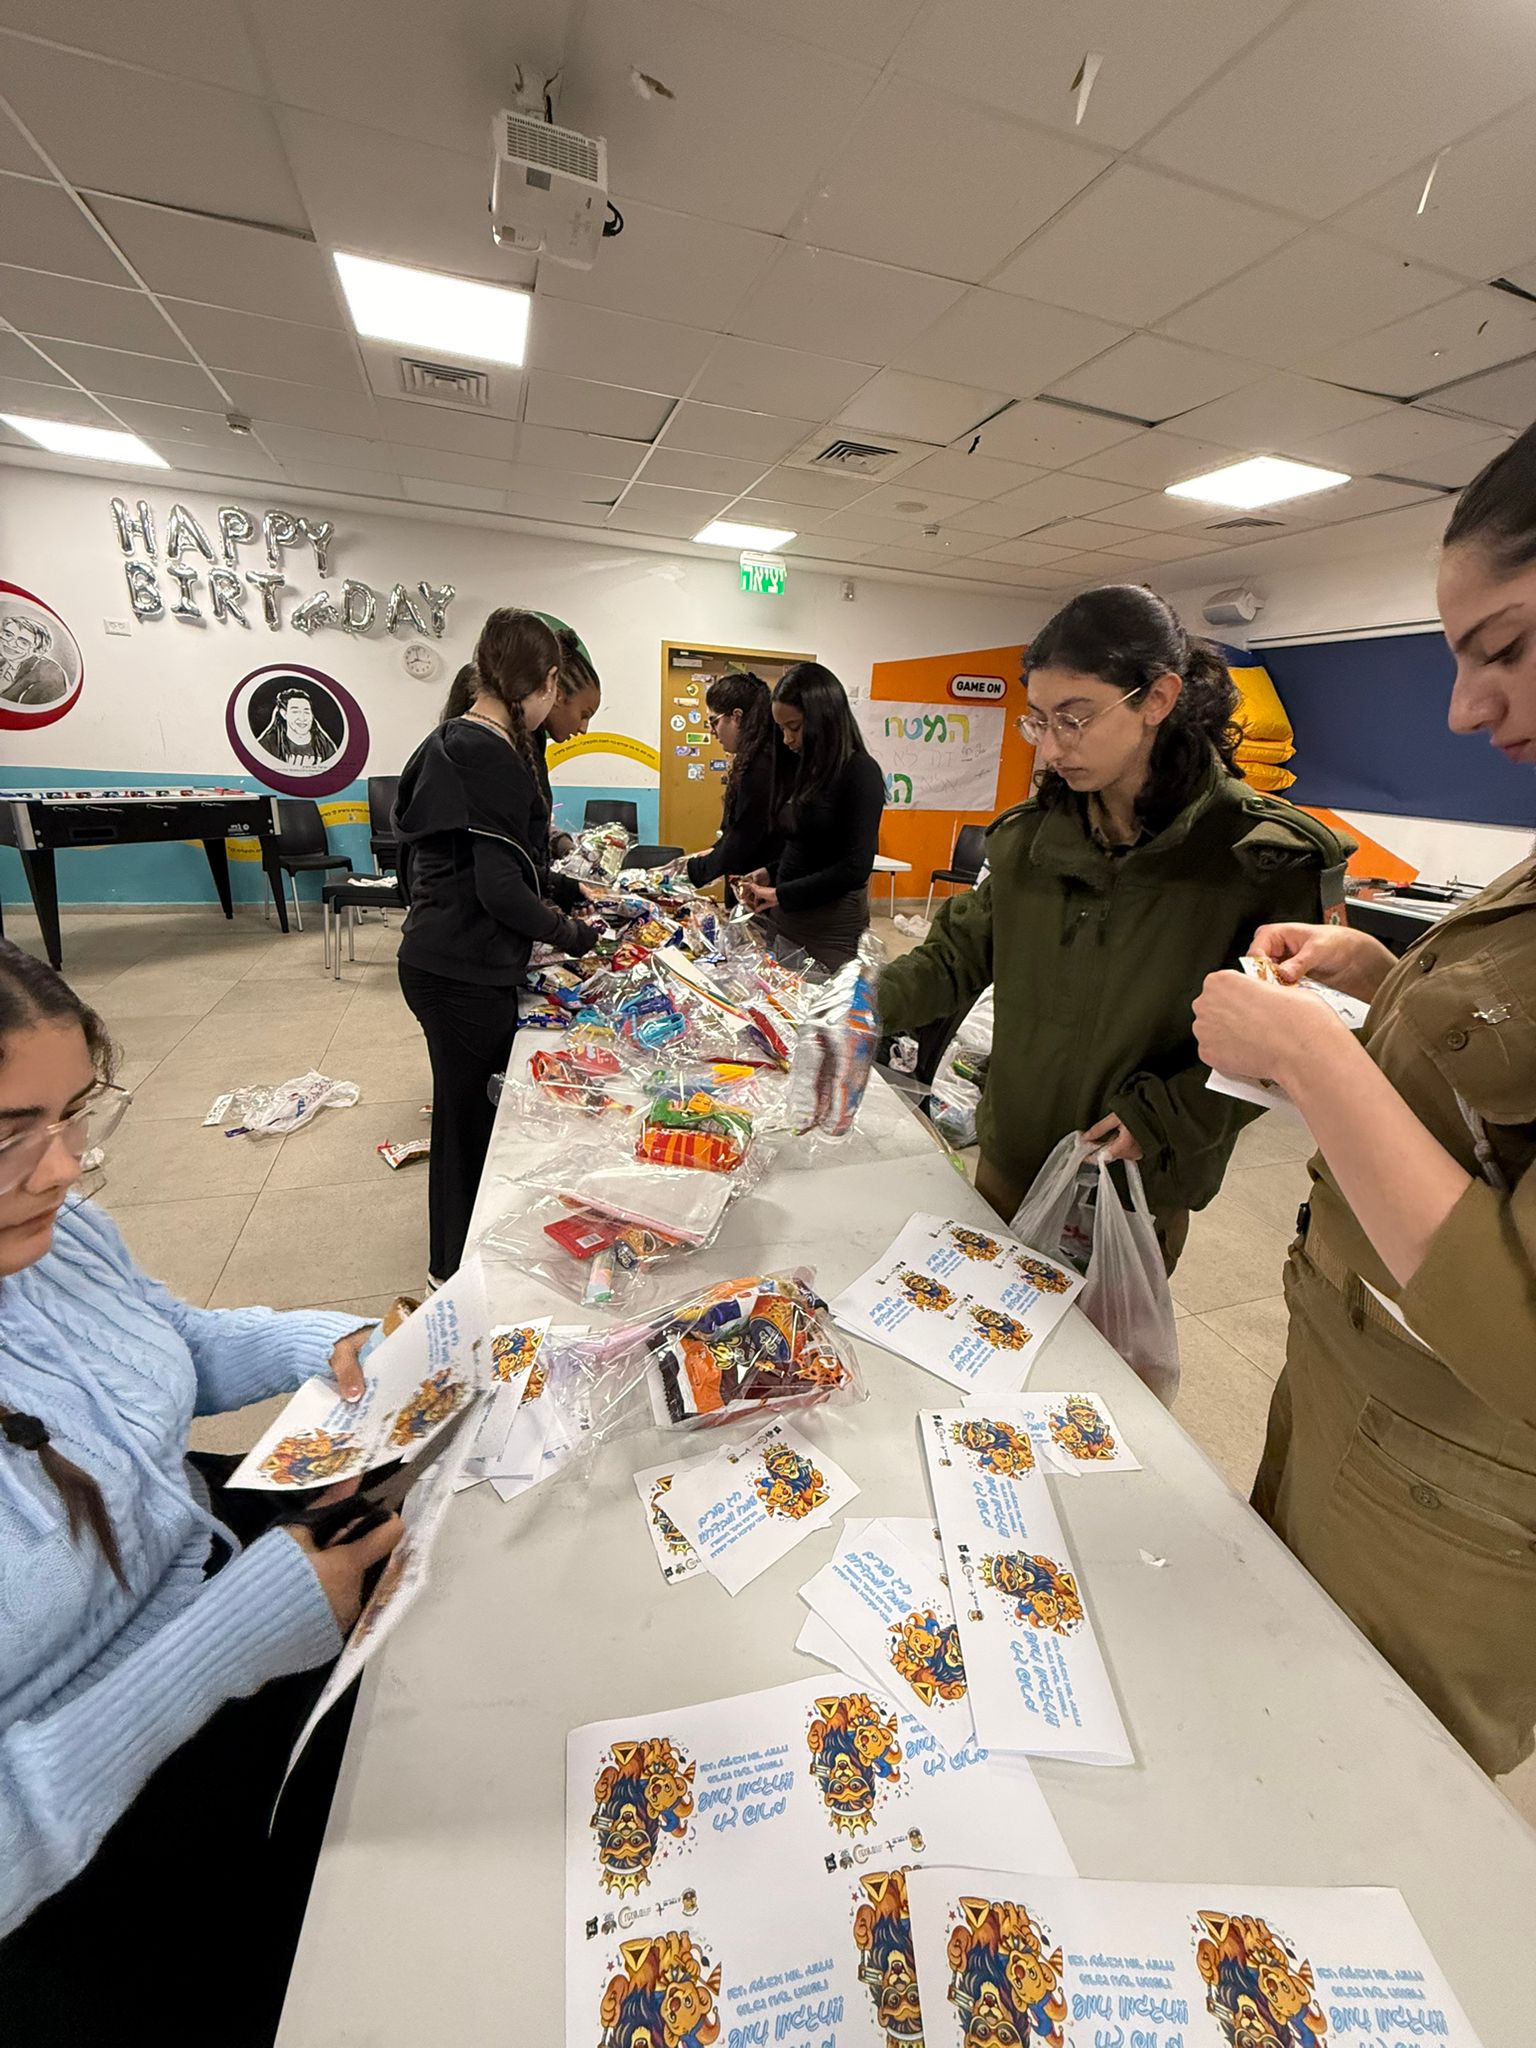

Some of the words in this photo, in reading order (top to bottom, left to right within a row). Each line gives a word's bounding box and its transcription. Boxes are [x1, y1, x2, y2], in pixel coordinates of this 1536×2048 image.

[110, 497, 335, 578] HAPPY
[741, 565, 785, 594] יציאה
[956, 681, 985, 692] GAME
[986, 683, 1001, 693] ON
[885, 713, 971, 744] המטרו
[1009, 1640, 1029, 1665] חג
[1022, 1629, 1044, 1664] שמח
[1015, 1667, 1039, 1714] פורים
[905, 1735, 937, 1760] שמח
[923, 1753, 946, 1777] חג
[698, 1786, 732, 1813] שמח
[712, 1806, 739, 1833] חג
[742, 1796, 786, 1826] פורים
[1071, 1993, 1113, 2021] שמח
[1329, 2006, 1372, 2034] שמח
[728, 2019, 769, 2048] שמח
